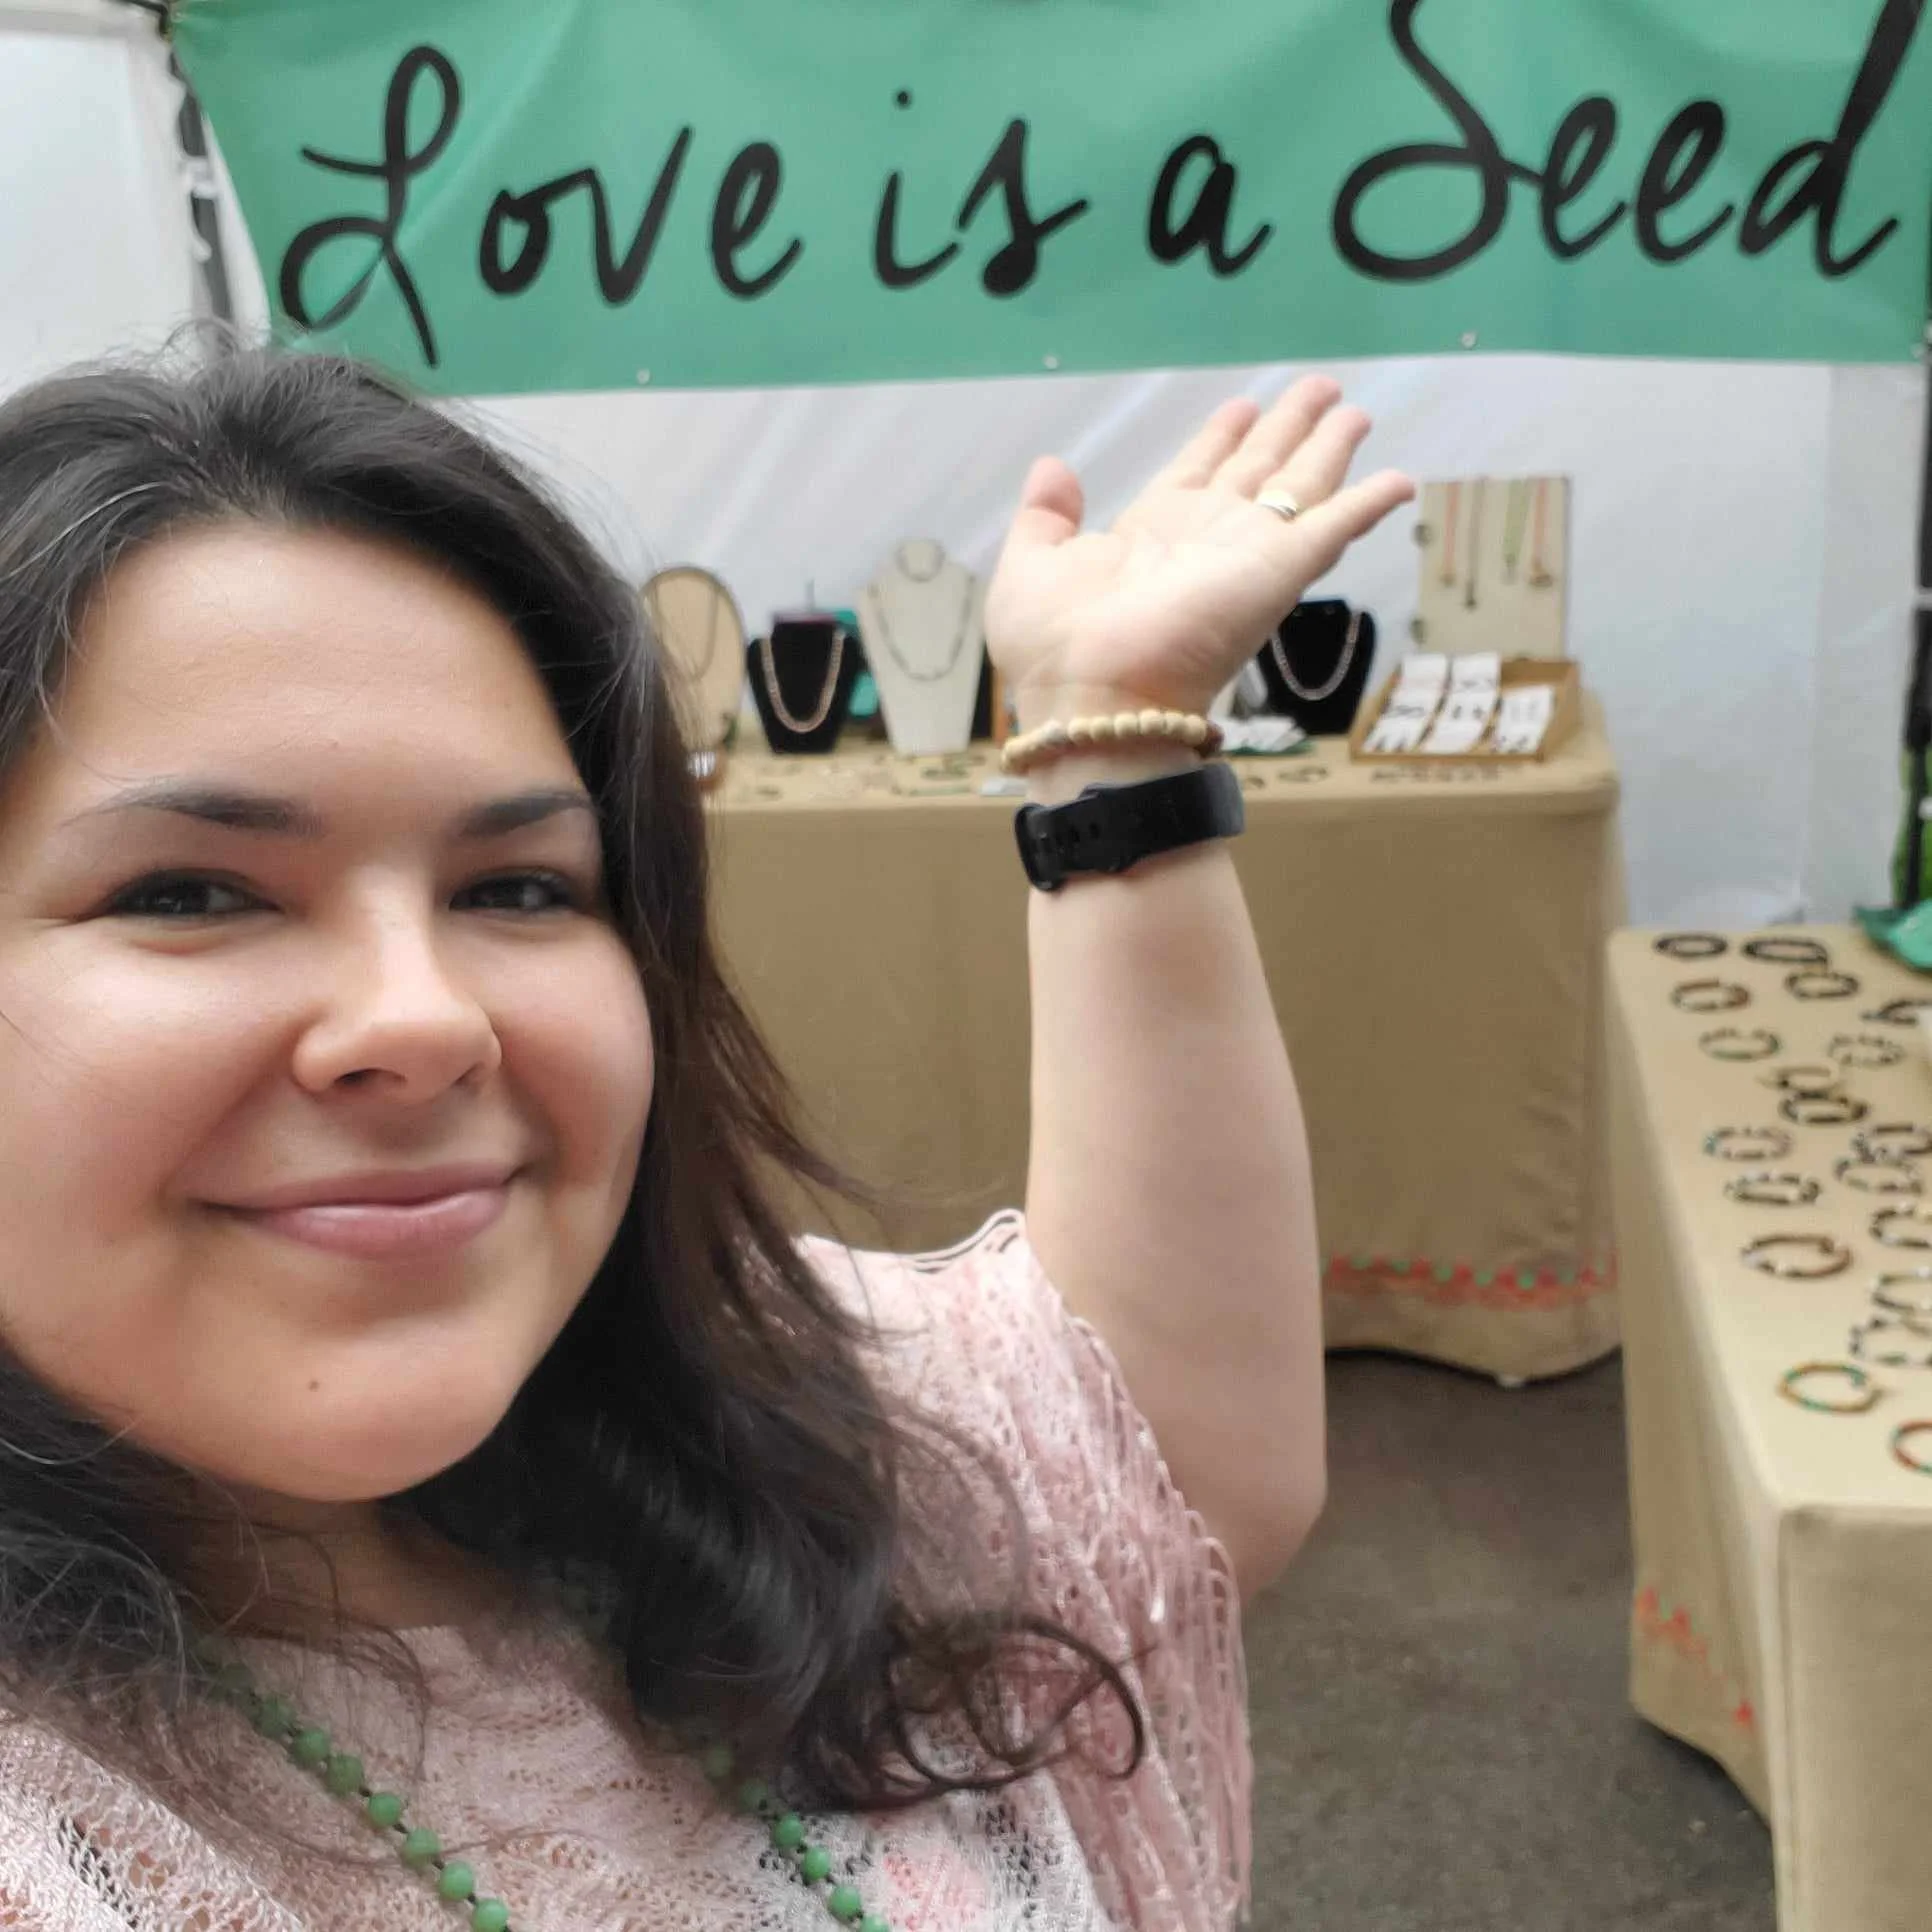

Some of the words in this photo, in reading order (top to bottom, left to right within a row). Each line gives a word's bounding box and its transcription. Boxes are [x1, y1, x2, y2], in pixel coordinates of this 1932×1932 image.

[279, 44, 806, 369] Love
[874, 88, 1091, 298] is
[1146, 134, 1272, 278] a
[1332, 0, 1924, 282] Seed
